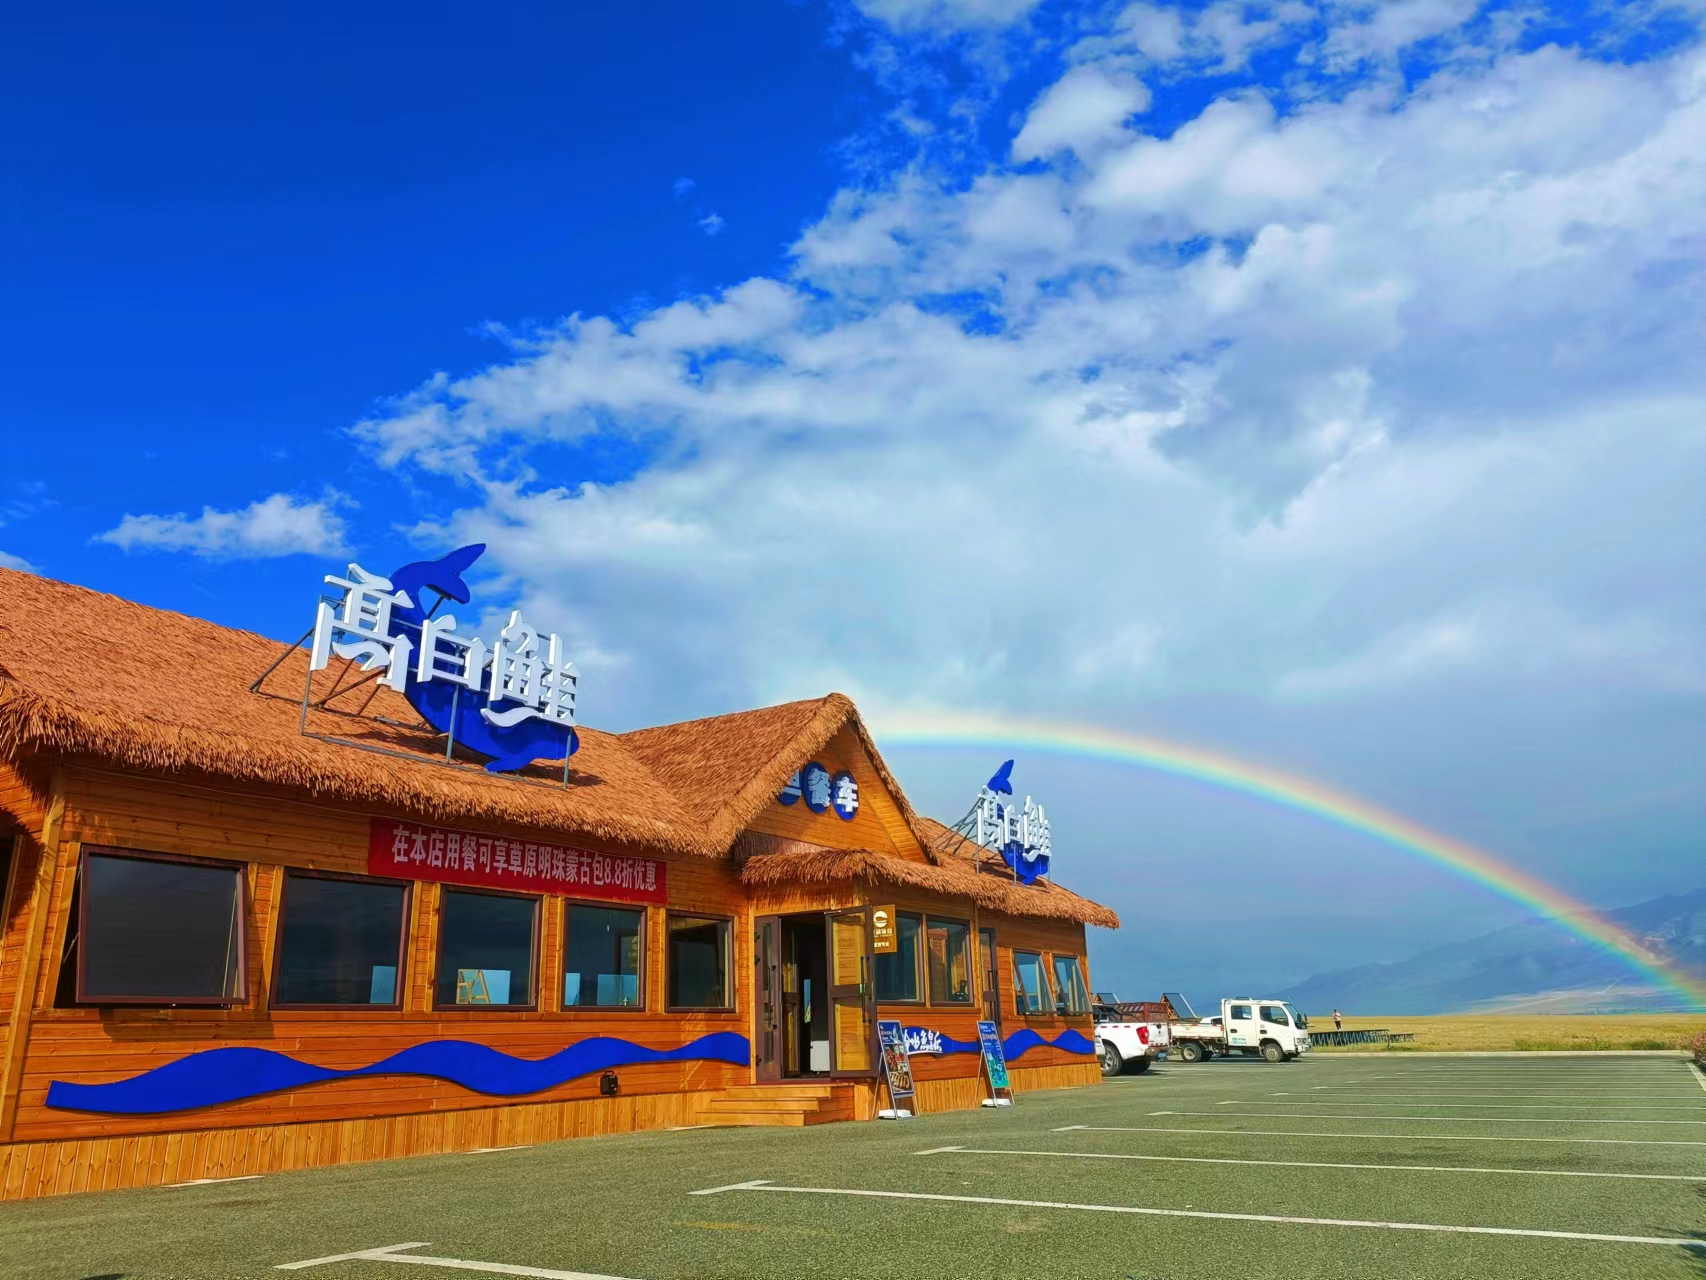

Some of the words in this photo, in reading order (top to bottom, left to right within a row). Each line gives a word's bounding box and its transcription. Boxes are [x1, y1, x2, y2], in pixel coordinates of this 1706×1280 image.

[391, 825, 658, 892] 在本店用餐可享草原明珠蒙古包8.8折优惠
